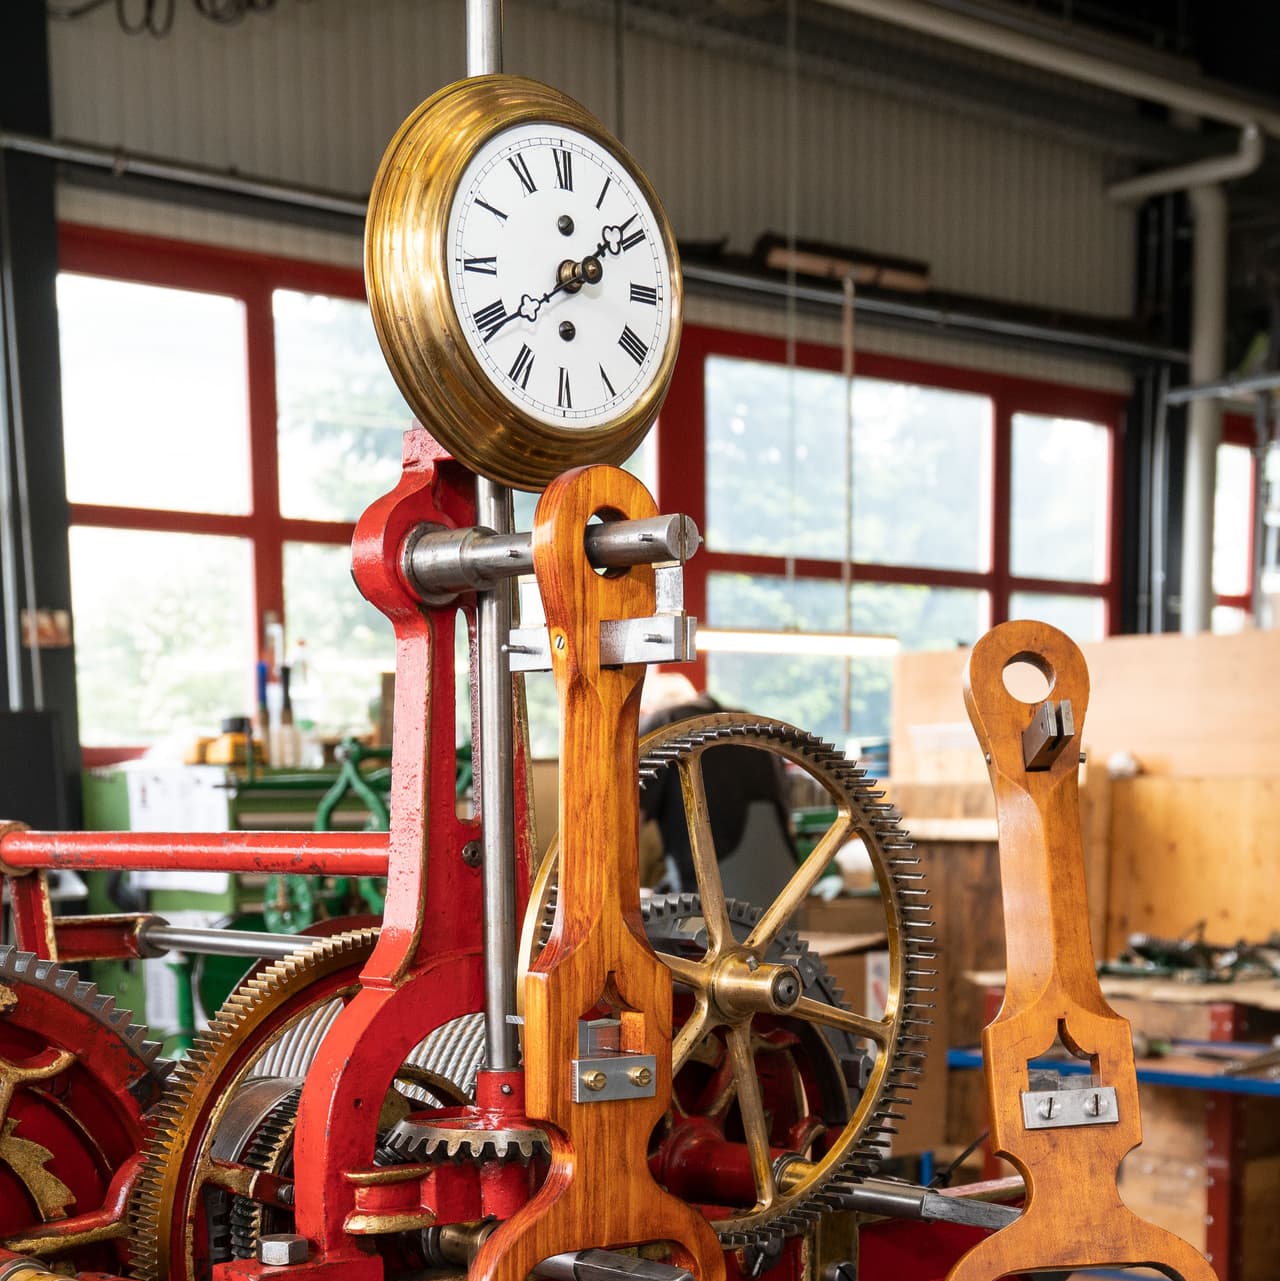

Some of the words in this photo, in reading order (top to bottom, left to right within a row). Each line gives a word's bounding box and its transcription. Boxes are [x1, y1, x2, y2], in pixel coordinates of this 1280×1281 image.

[506, 151, 538, 198] XI
[550, 147, 574, 193] XII
[473, 190, 508, 228] X
[595, 177, 612, 211] I
[621, 228, 646, 252] II
[463, 250, 497, 278] IX
[629, 280, 657, 307] III
[617, 322, 649, 367] IIII
[507, 342, 536, 391] VII
[598, 362, 617, 401] V
[557, 366, 573, 409] VI
